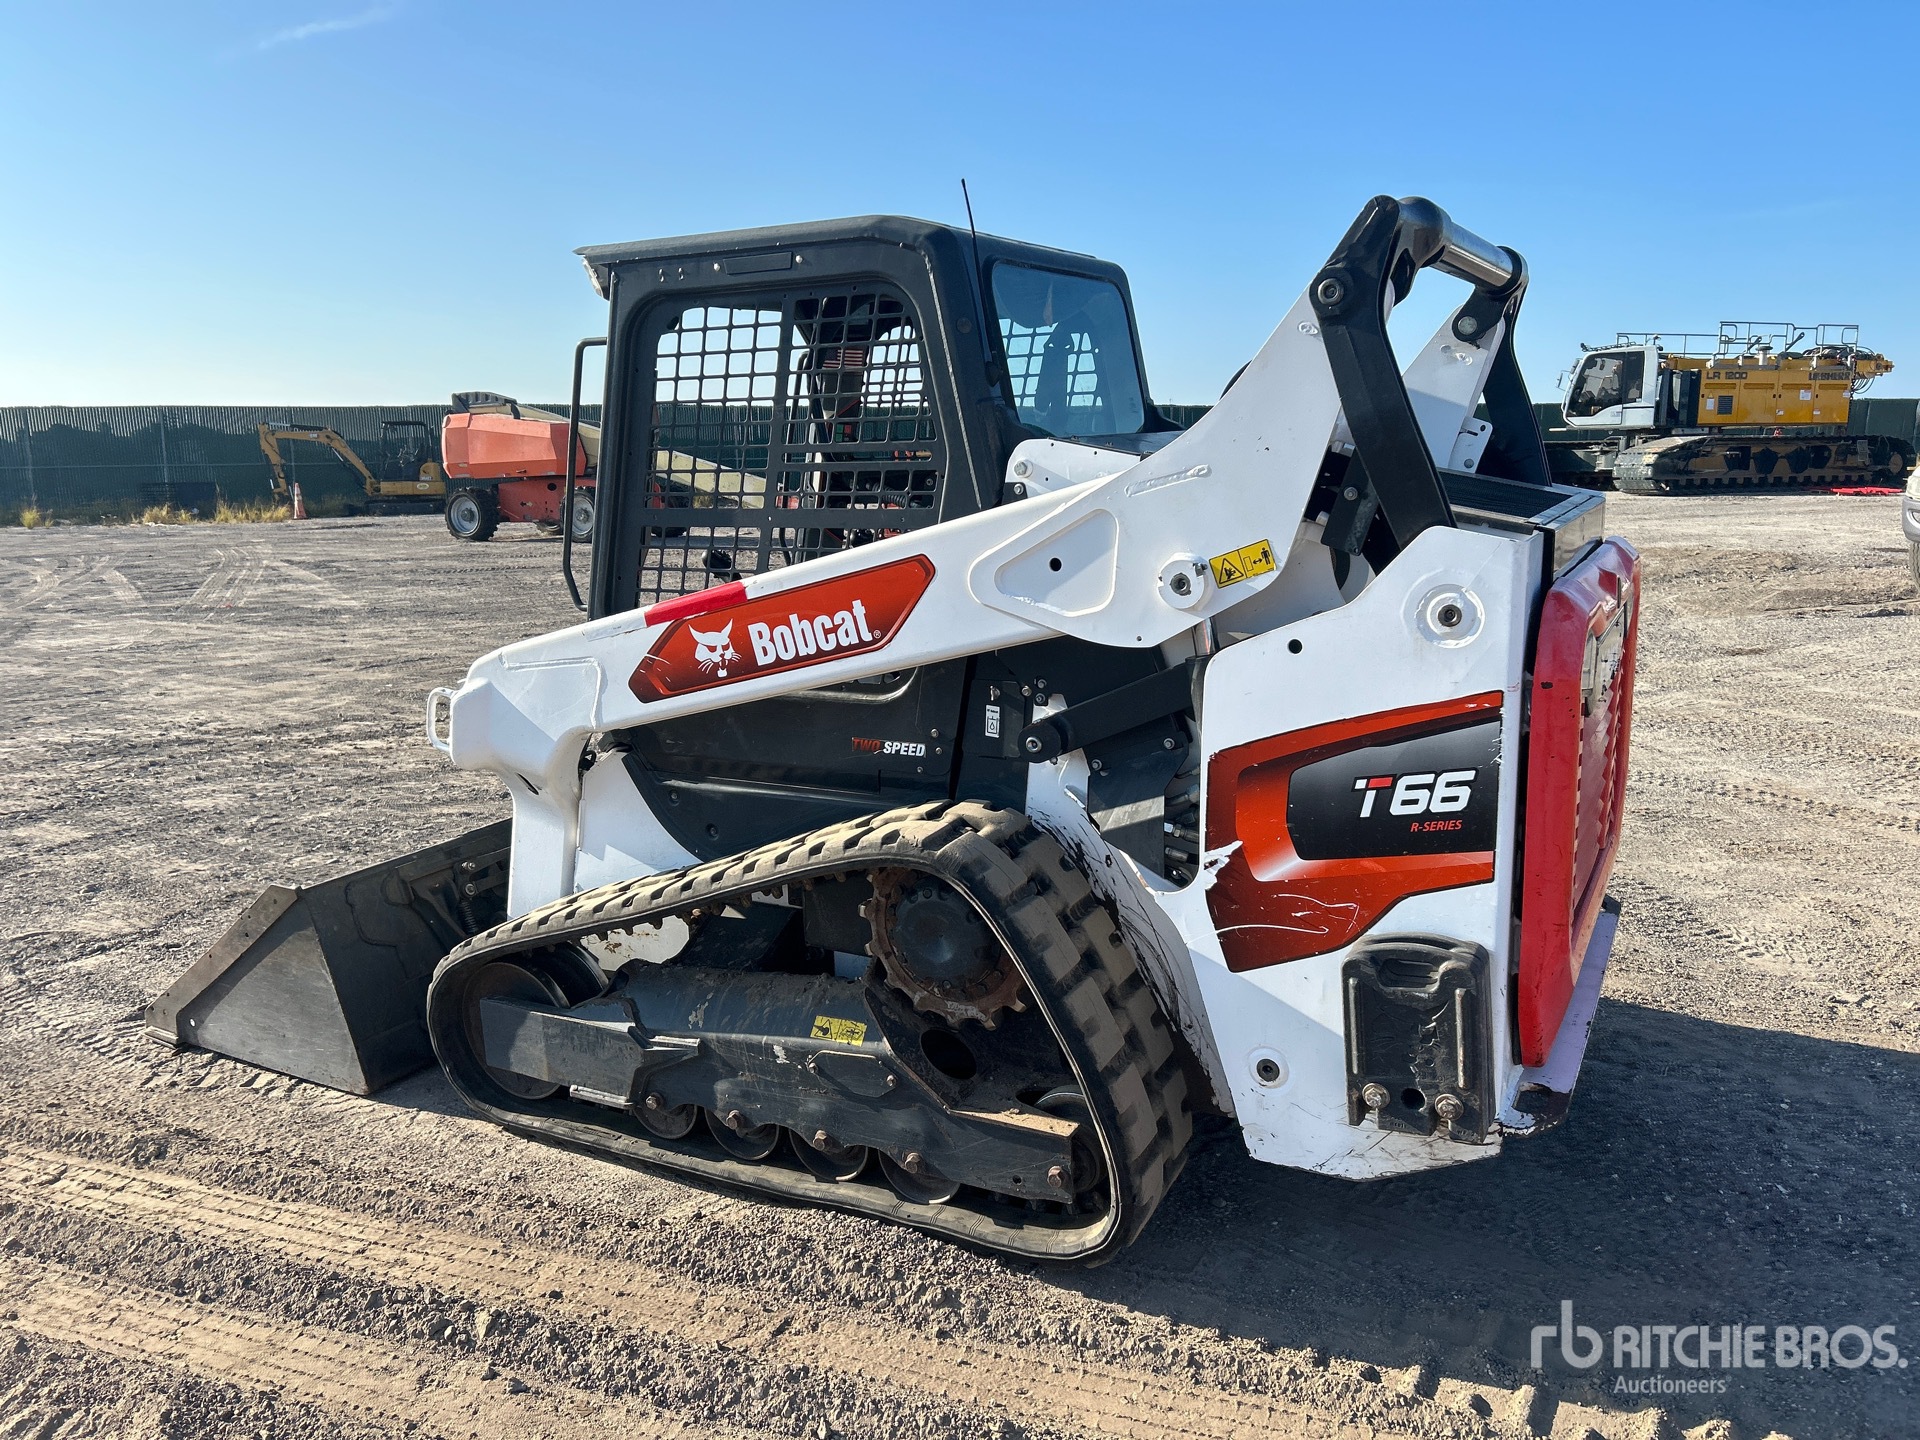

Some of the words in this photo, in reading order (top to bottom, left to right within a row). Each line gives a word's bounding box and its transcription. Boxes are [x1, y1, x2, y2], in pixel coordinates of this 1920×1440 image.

[1706, 371, 1721, 380] LR
[1725, 371, 1748, 380] 1200
[747, 599, 873, 667] Bobcat
[853, 738, 881, 752] TWO
[883, 741, 926, 757] SPEED
[1354, 770, 1476, 818] T66
[1410, 820, 1463, 832] R-SERIES
